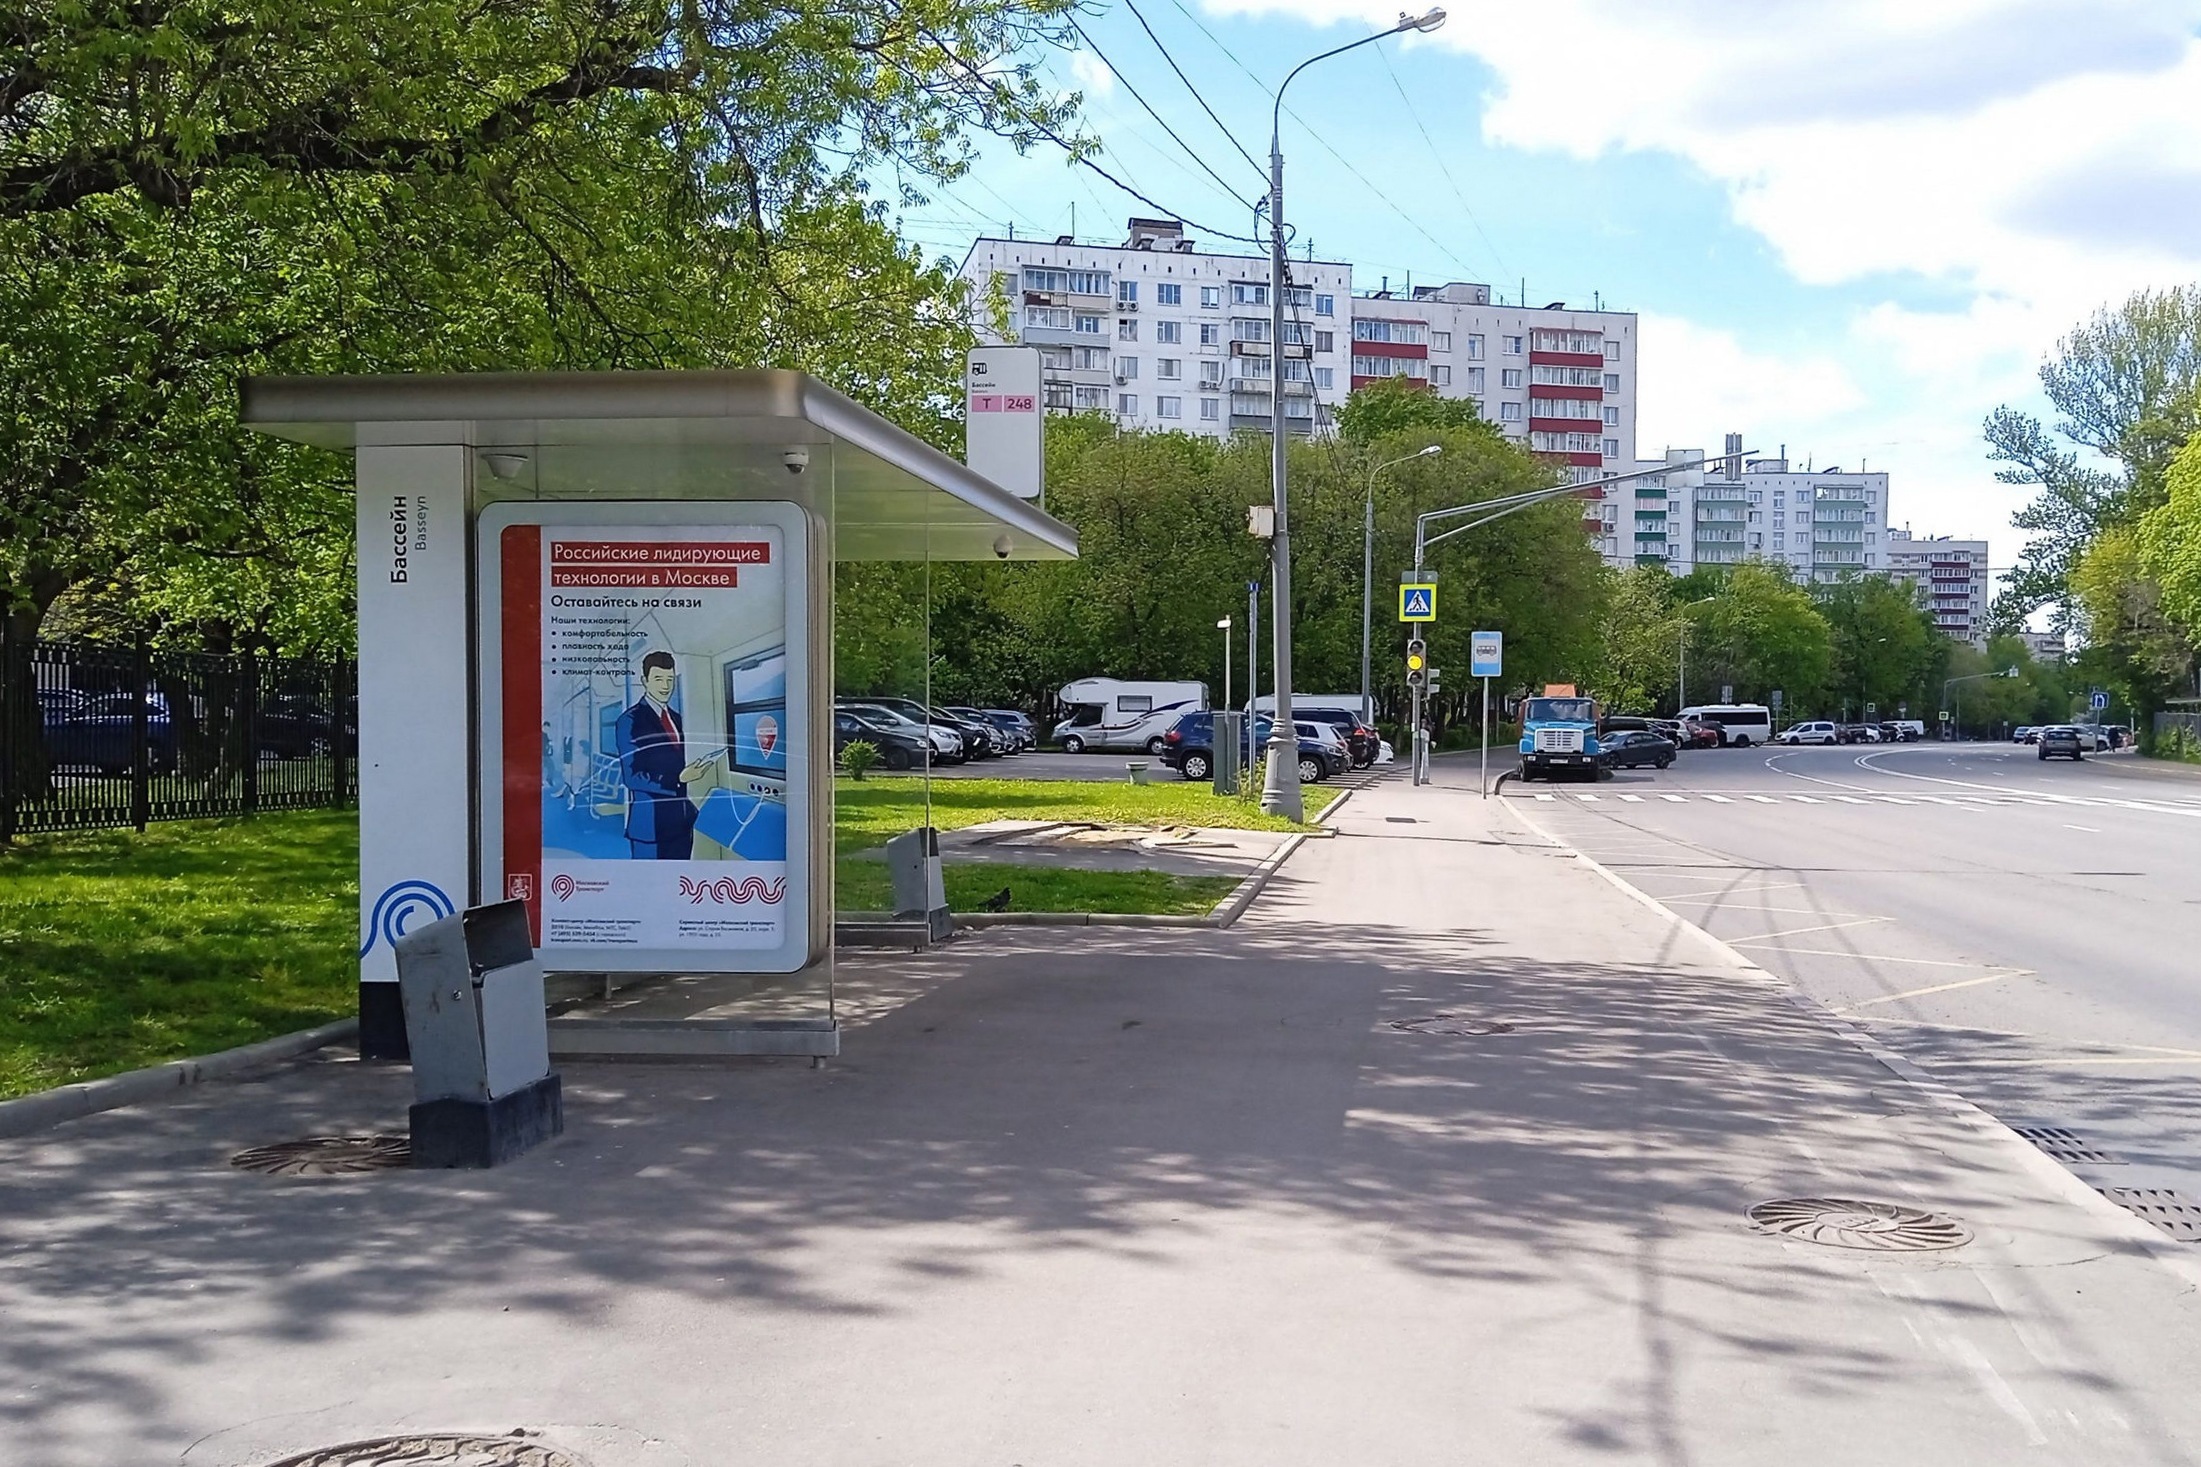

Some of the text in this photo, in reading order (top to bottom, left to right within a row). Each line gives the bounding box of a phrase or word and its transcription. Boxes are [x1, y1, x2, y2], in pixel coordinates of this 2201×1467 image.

[1007, 398, 1032, 410] 248
[415, 496, 429, 550] Basseyn
[390, 496, 407, 583] Бассейн
[554, 544, 761, 564] Российские лидирующие
[554, 569, 730, 585] технологии в Москве
[551, 595, 702, 608] Оставайтесь на связи
[551, 616, 575, 624] Наши
[562, 629, 648, 639] комфортабельность
[562, 669, 636, 677] климат-контроль
